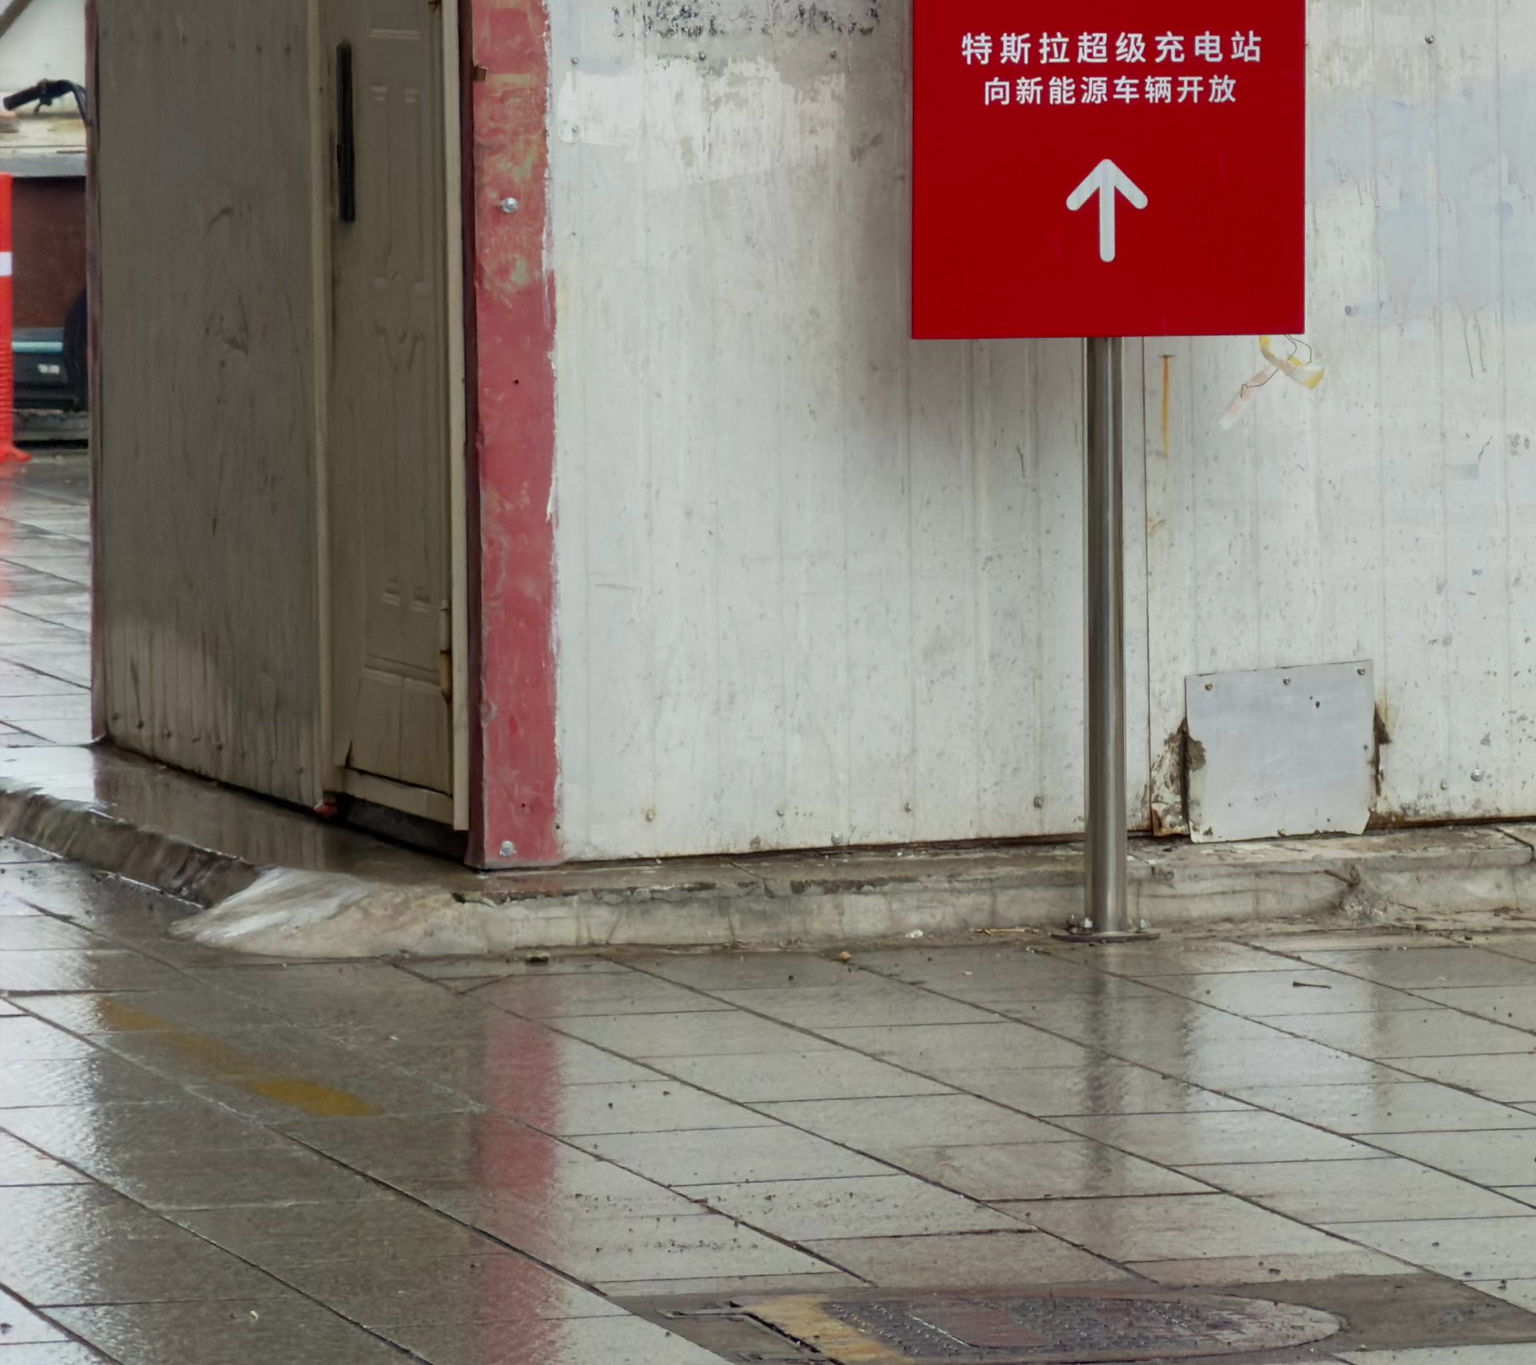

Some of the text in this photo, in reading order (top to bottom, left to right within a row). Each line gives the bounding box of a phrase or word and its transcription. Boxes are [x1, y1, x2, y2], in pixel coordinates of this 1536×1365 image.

[961, 30, 1263, 65] 特斯拉超级充电站
[983, 74, 1237, 106] 向新能源车辆开放
